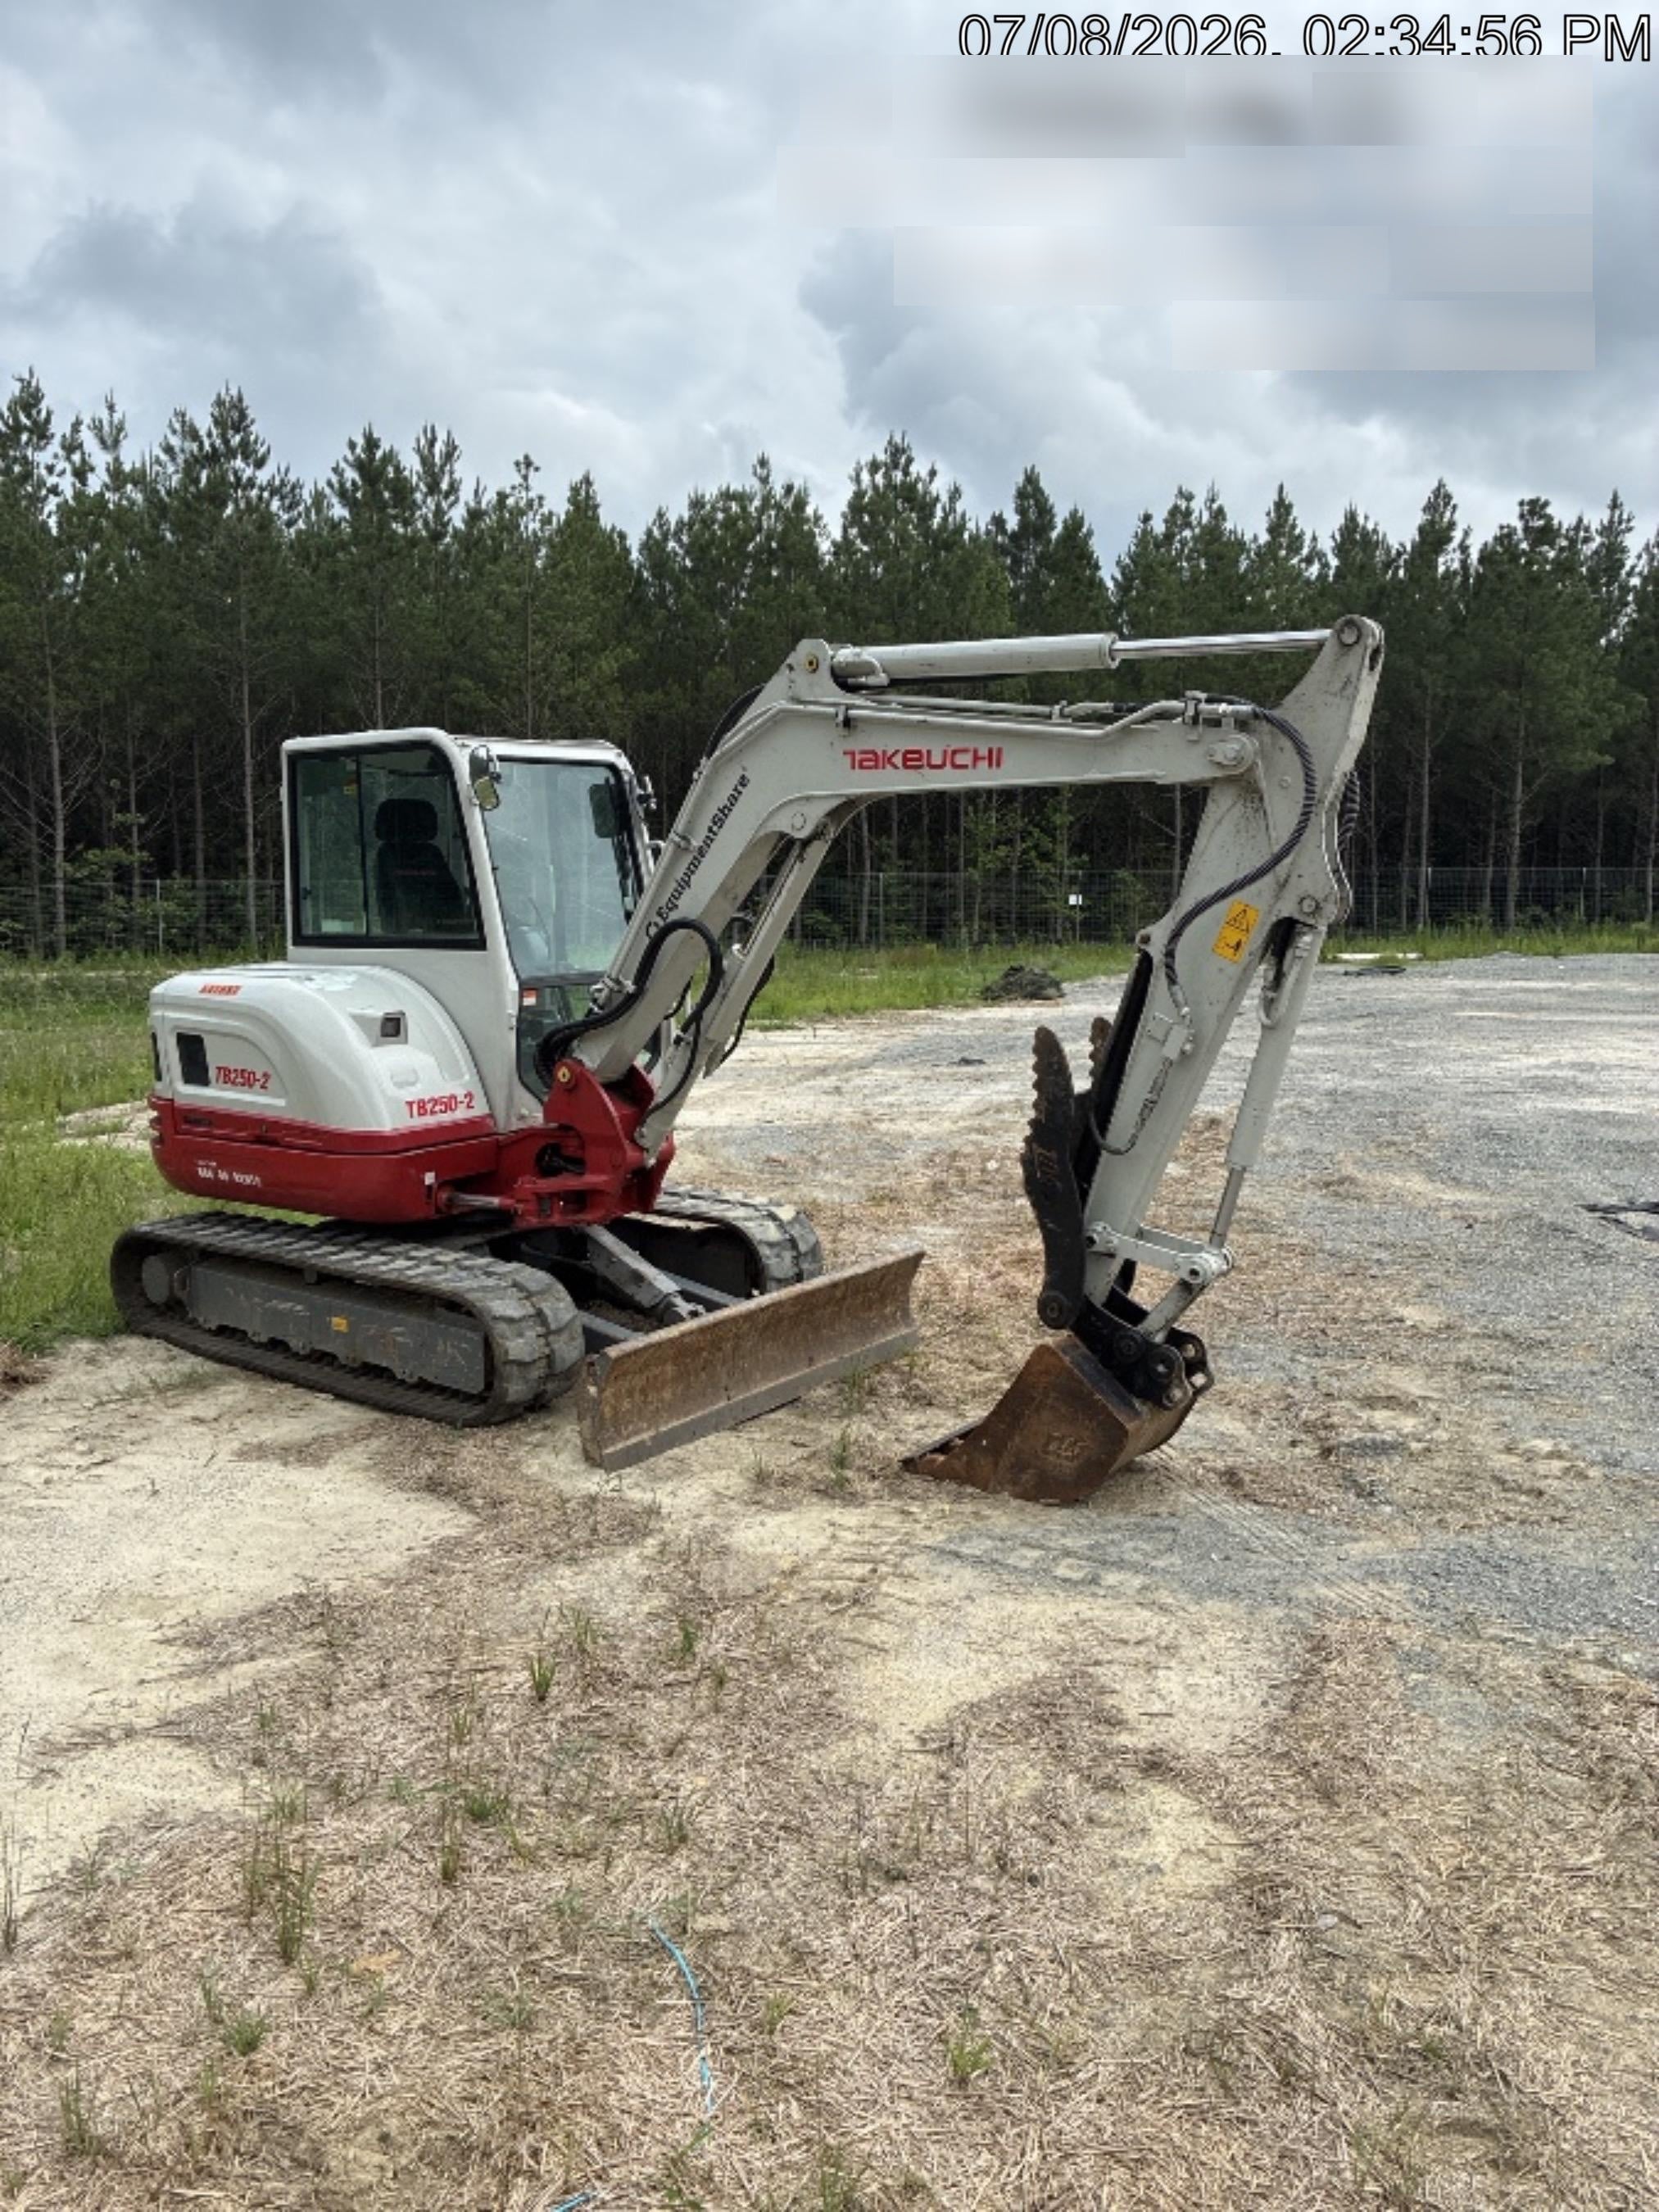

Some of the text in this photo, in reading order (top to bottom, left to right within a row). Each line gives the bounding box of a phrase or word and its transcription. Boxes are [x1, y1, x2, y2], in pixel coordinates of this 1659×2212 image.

[656, 773, 750, 922] EquipmentShare
[215, 1066, 270, 1090] TB250-2
[405, 1090, 474, 1119] TB250-2
